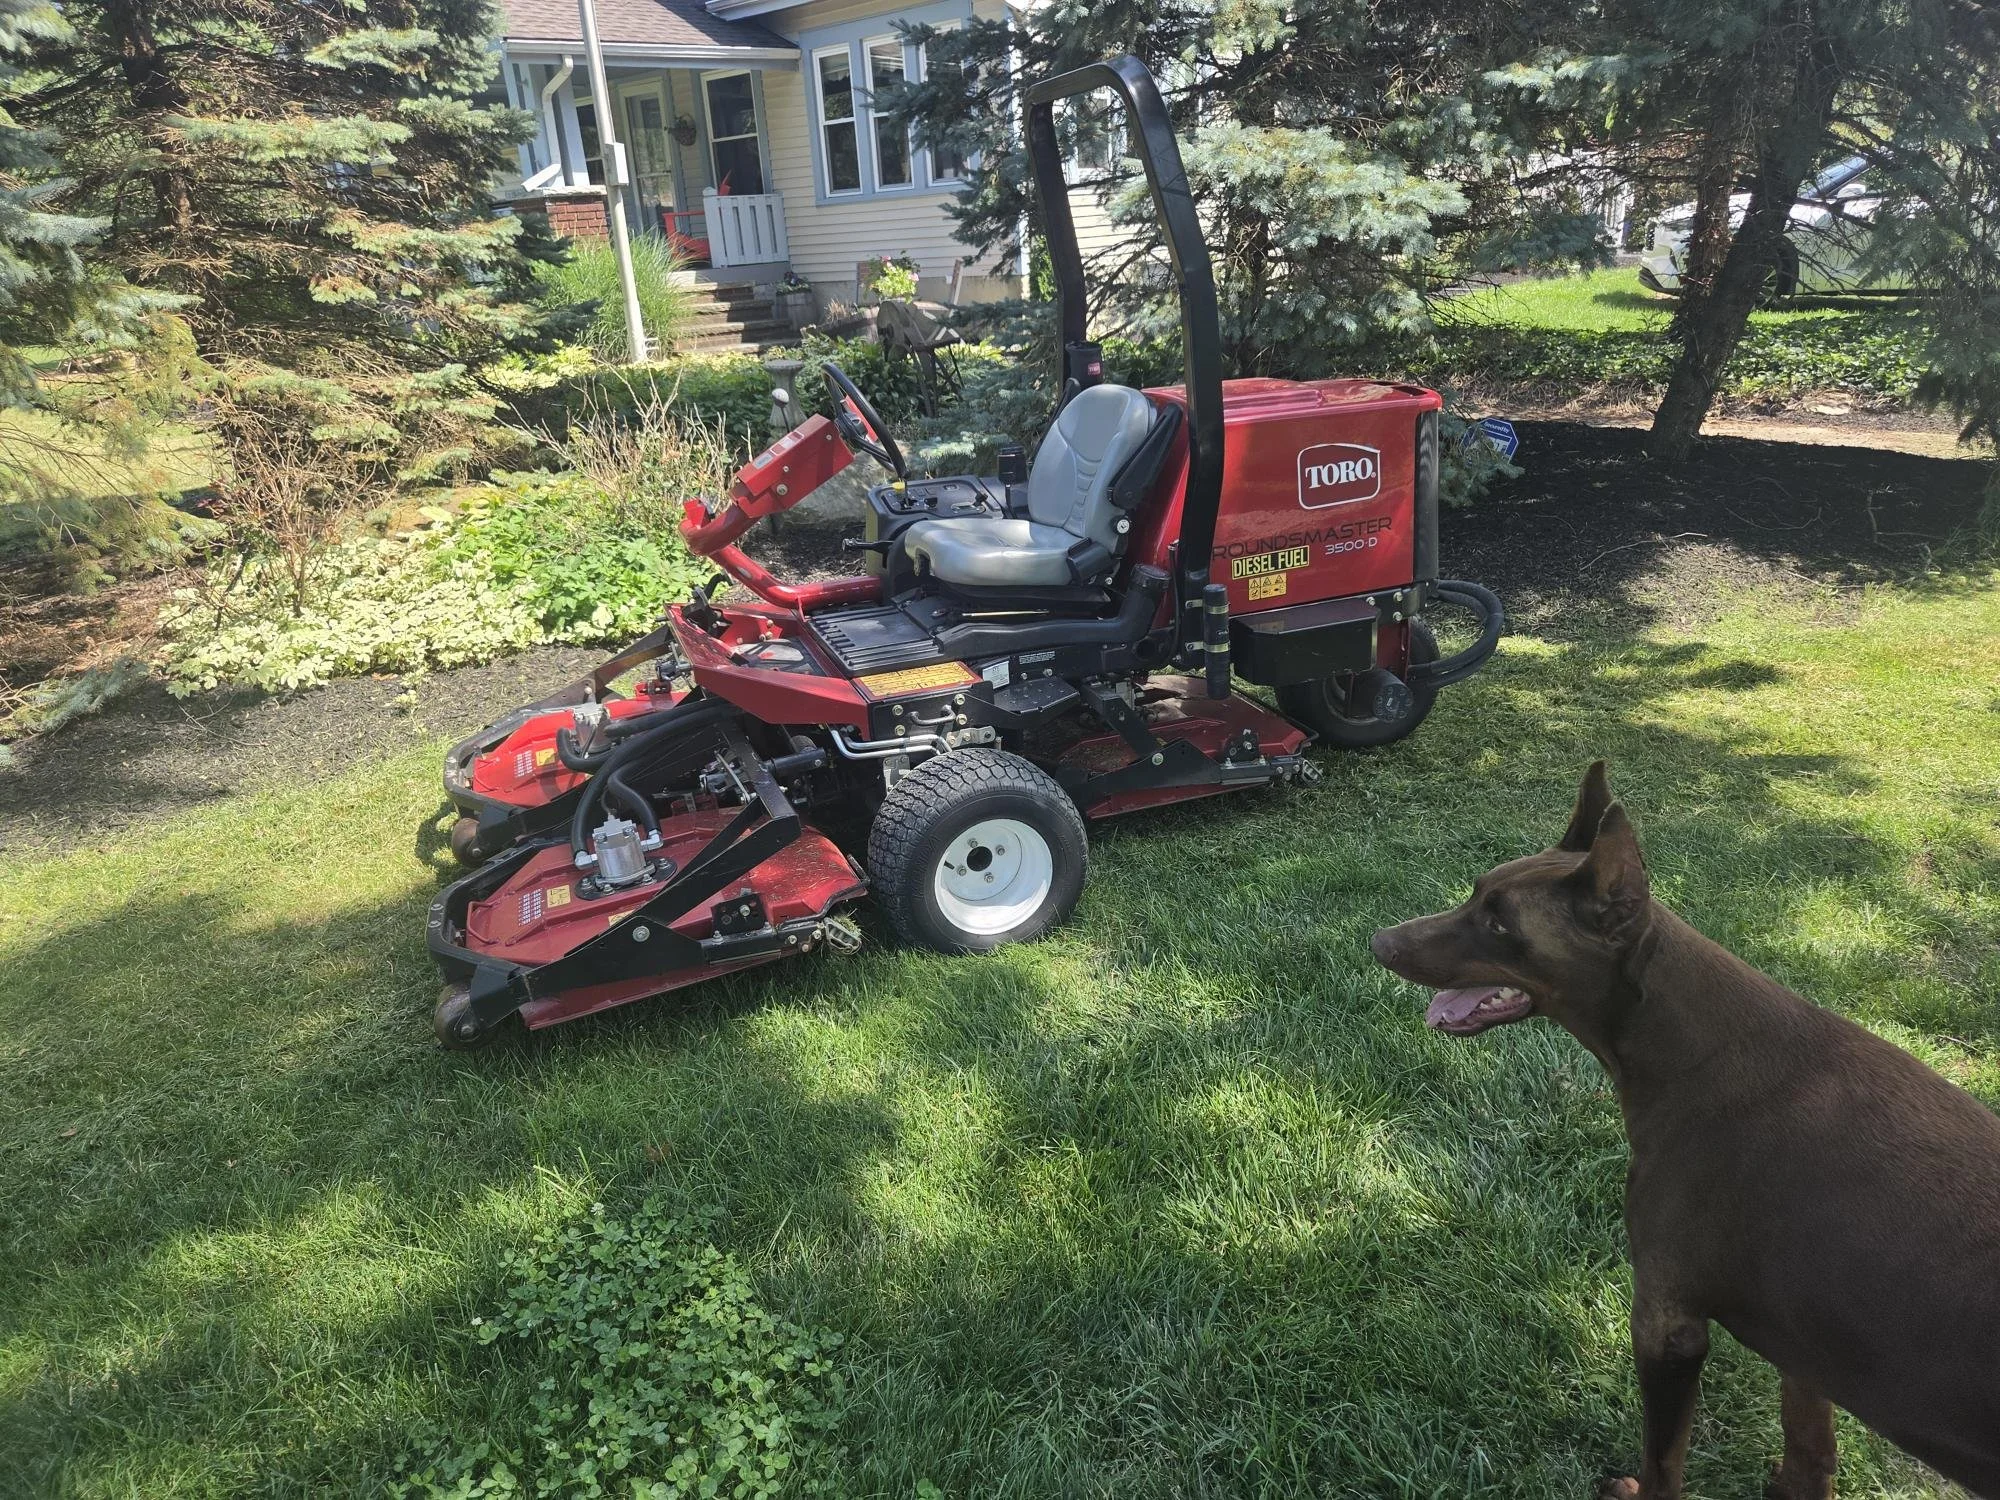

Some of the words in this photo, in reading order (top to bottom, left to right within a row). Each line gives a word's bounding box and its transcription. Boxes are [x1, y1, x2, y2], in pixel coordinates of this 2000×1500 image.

[1305, 457, 1373, 489] TORO
[1212, 516, 1392, 560] ROUNDSMASTER
[1233, 554, 1276, 577] DIESEL
[1278, 548, 1308, 569] FUEL
